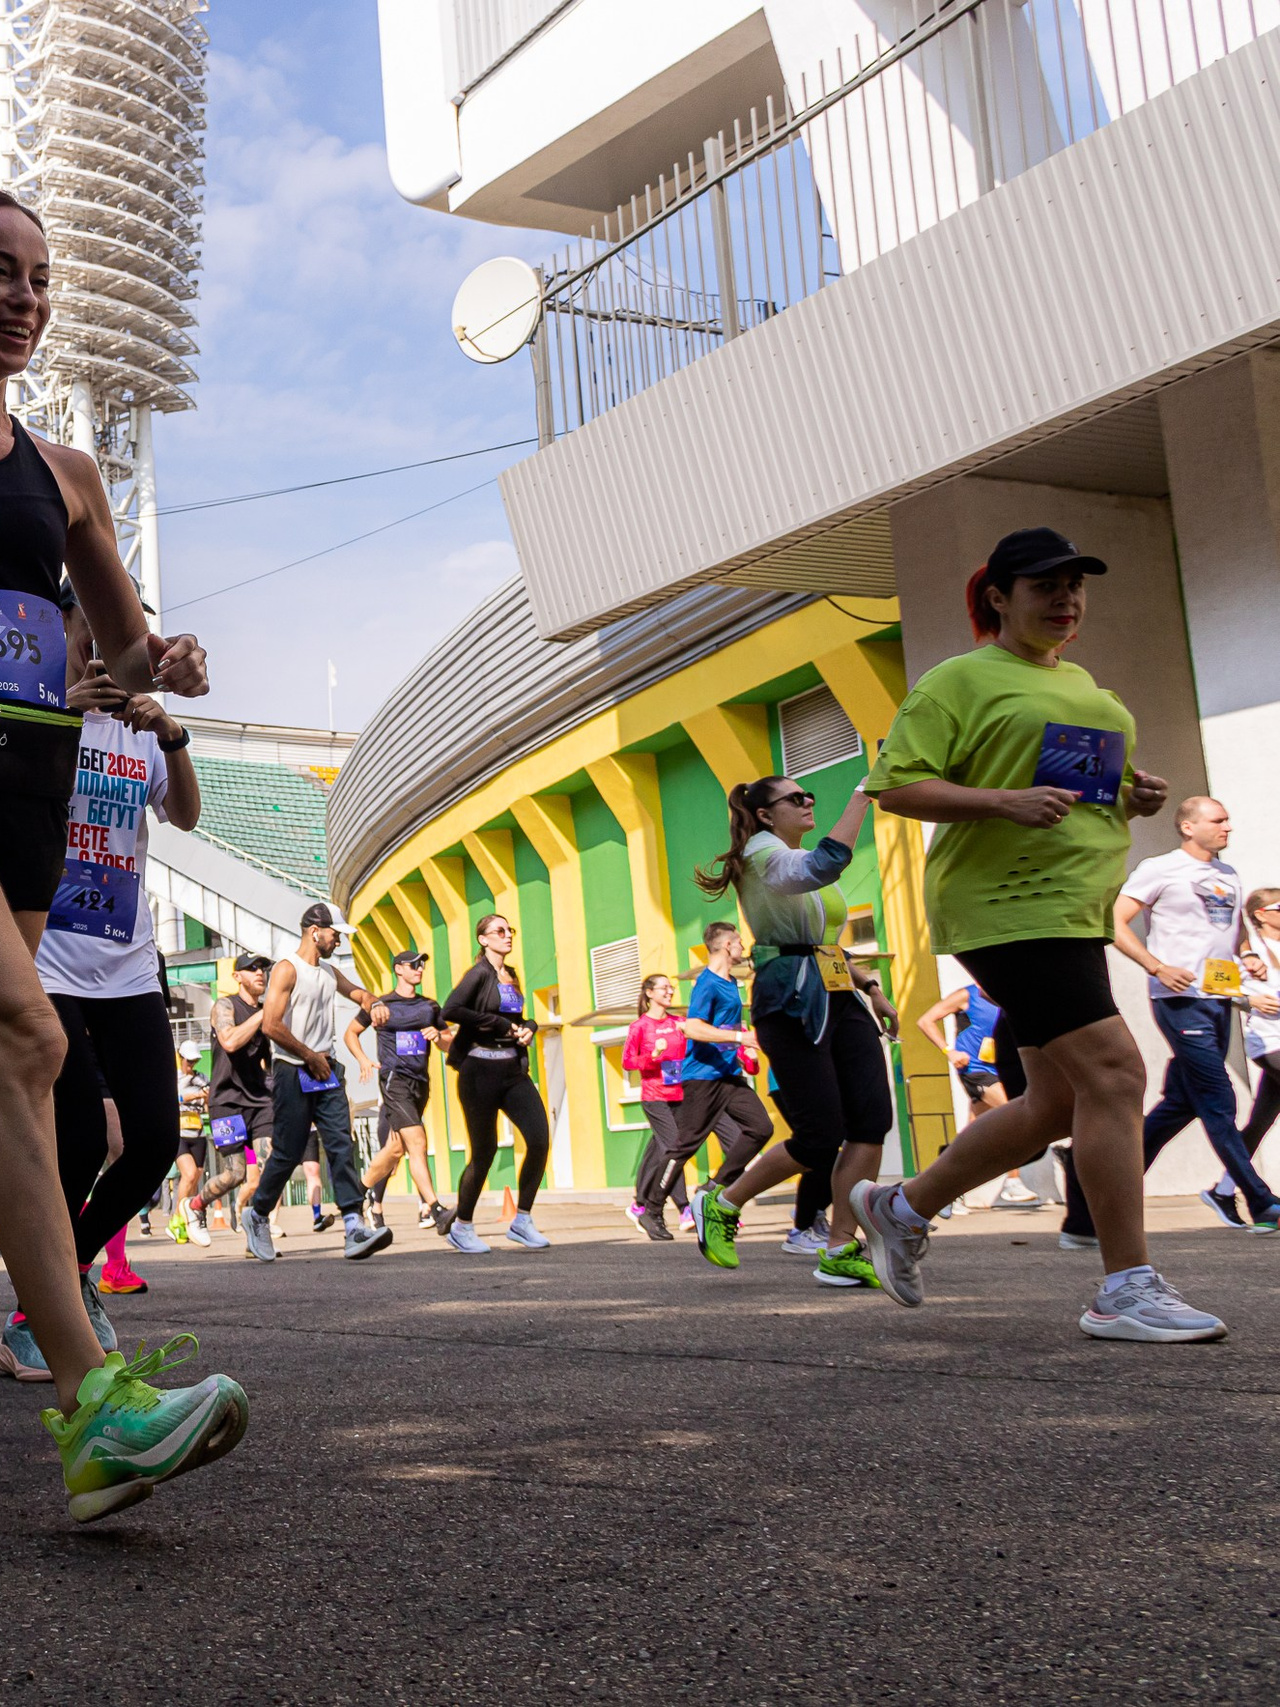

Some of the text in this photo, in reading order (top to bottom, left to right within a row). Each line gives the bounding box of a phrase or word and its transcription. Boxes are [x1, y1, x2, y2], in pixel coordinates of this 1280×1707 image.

[38, 682, 46, 699] 5
[77, 747, 147, 781] БЕГ2025
[1072, 755, 1104, 778] 431
[1096, 788, 1104, 801] 5
[87, 798, 137, 830] БЕГУТ
[67, 821, 109, 852] ЕСТЕ
[71, 889, 115, 913] 424
[72, 922, 88, 931] 2025
[104, 924, 111, 935] 5
